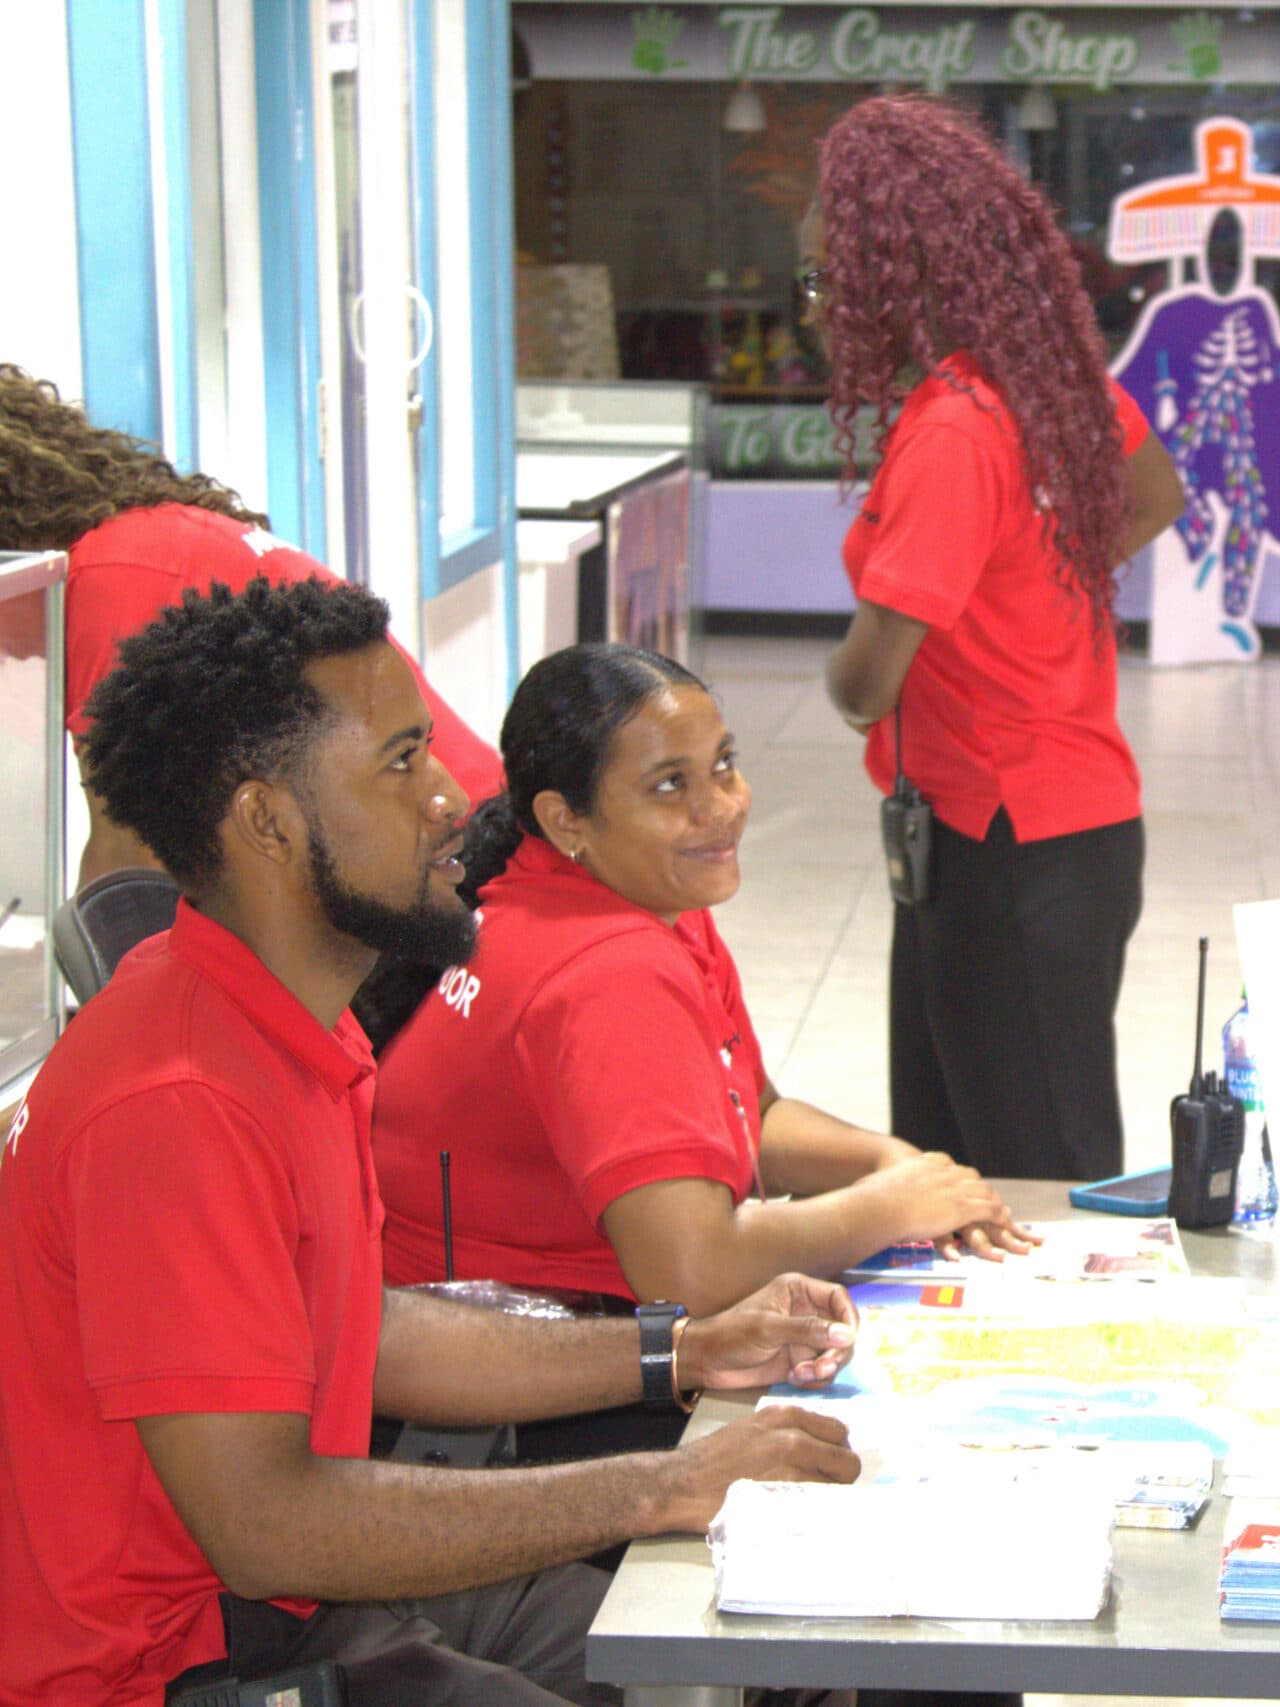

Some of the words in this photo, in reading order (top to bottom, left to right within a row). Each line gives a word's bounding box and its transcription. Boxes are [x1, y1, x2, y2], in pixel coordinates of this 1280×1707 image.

[719, 7, 814, 75] The
[830, 8, 977, 91] Craft
[1006, 10, 1138, 91] Shop
[721, 411, 770, 468] To
